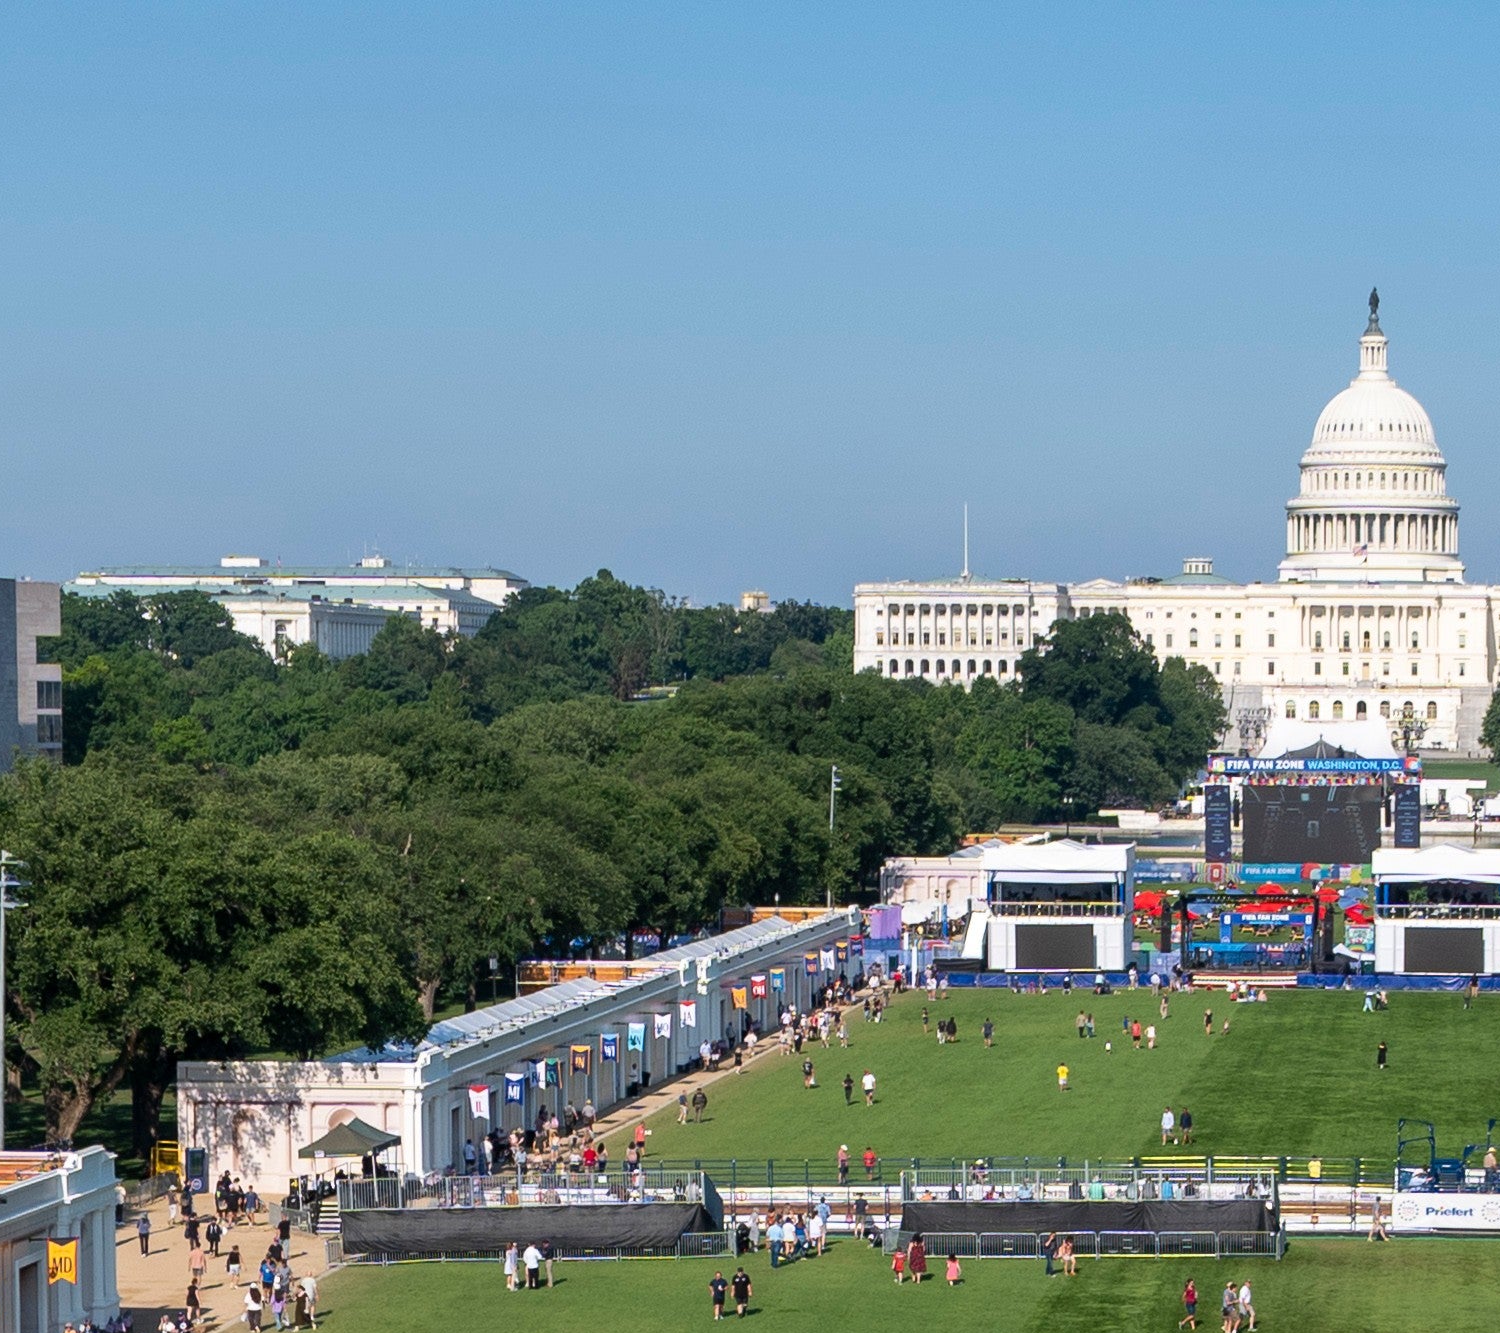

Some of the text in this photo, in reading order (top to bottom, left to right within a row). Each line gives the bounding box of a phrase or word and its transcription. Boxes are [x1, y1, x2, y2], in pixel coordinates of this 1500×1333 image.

[1227, 759, 1402, 771] FIFA FAN ZONE WASHINGTON, D.C.
[507, 1085, 521, 1100] MI
[475, 1101, 484, 1113] IL
[1425, 1206, 1474, 1217] Priefert
[52, 1256, 73, 1274] MD
